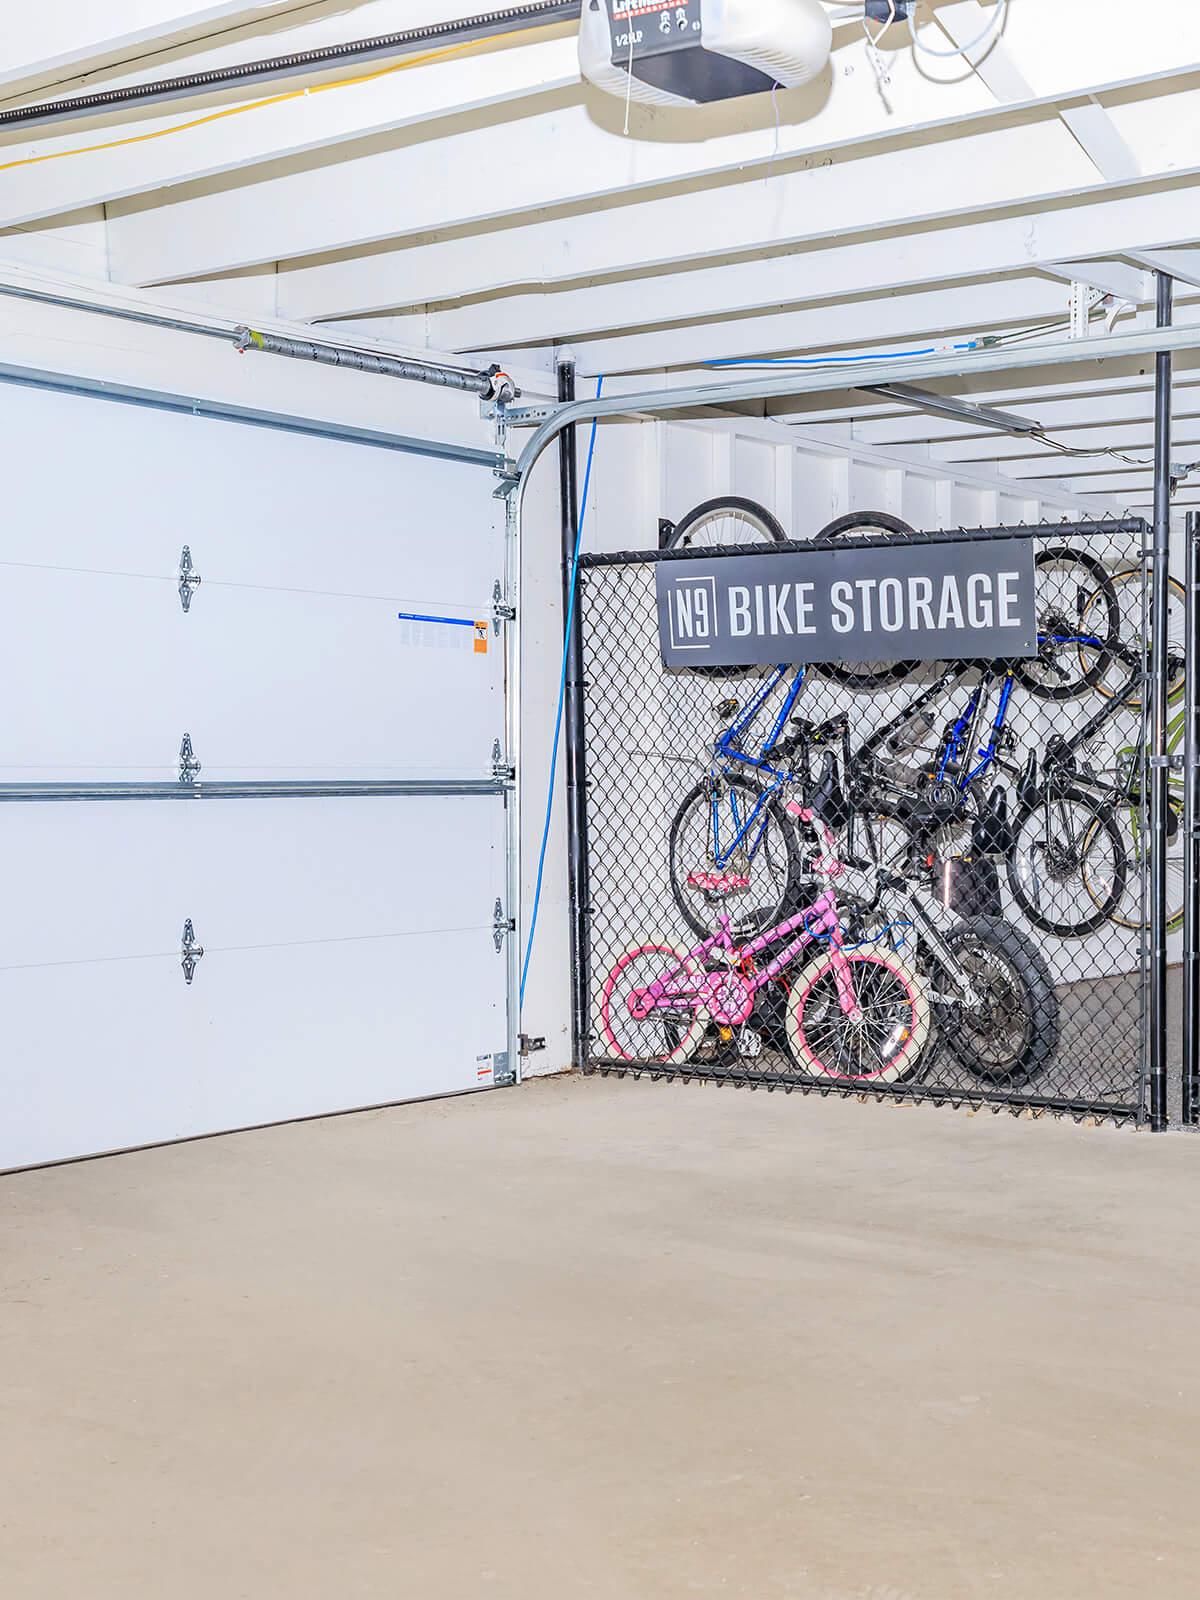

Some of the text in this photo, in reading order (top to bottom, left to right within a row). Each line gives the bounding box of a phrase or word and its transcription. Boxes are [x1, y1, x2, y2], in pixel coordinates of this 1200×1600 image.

[676, 571, 1022, 638] N9 BIKE STORAGE
